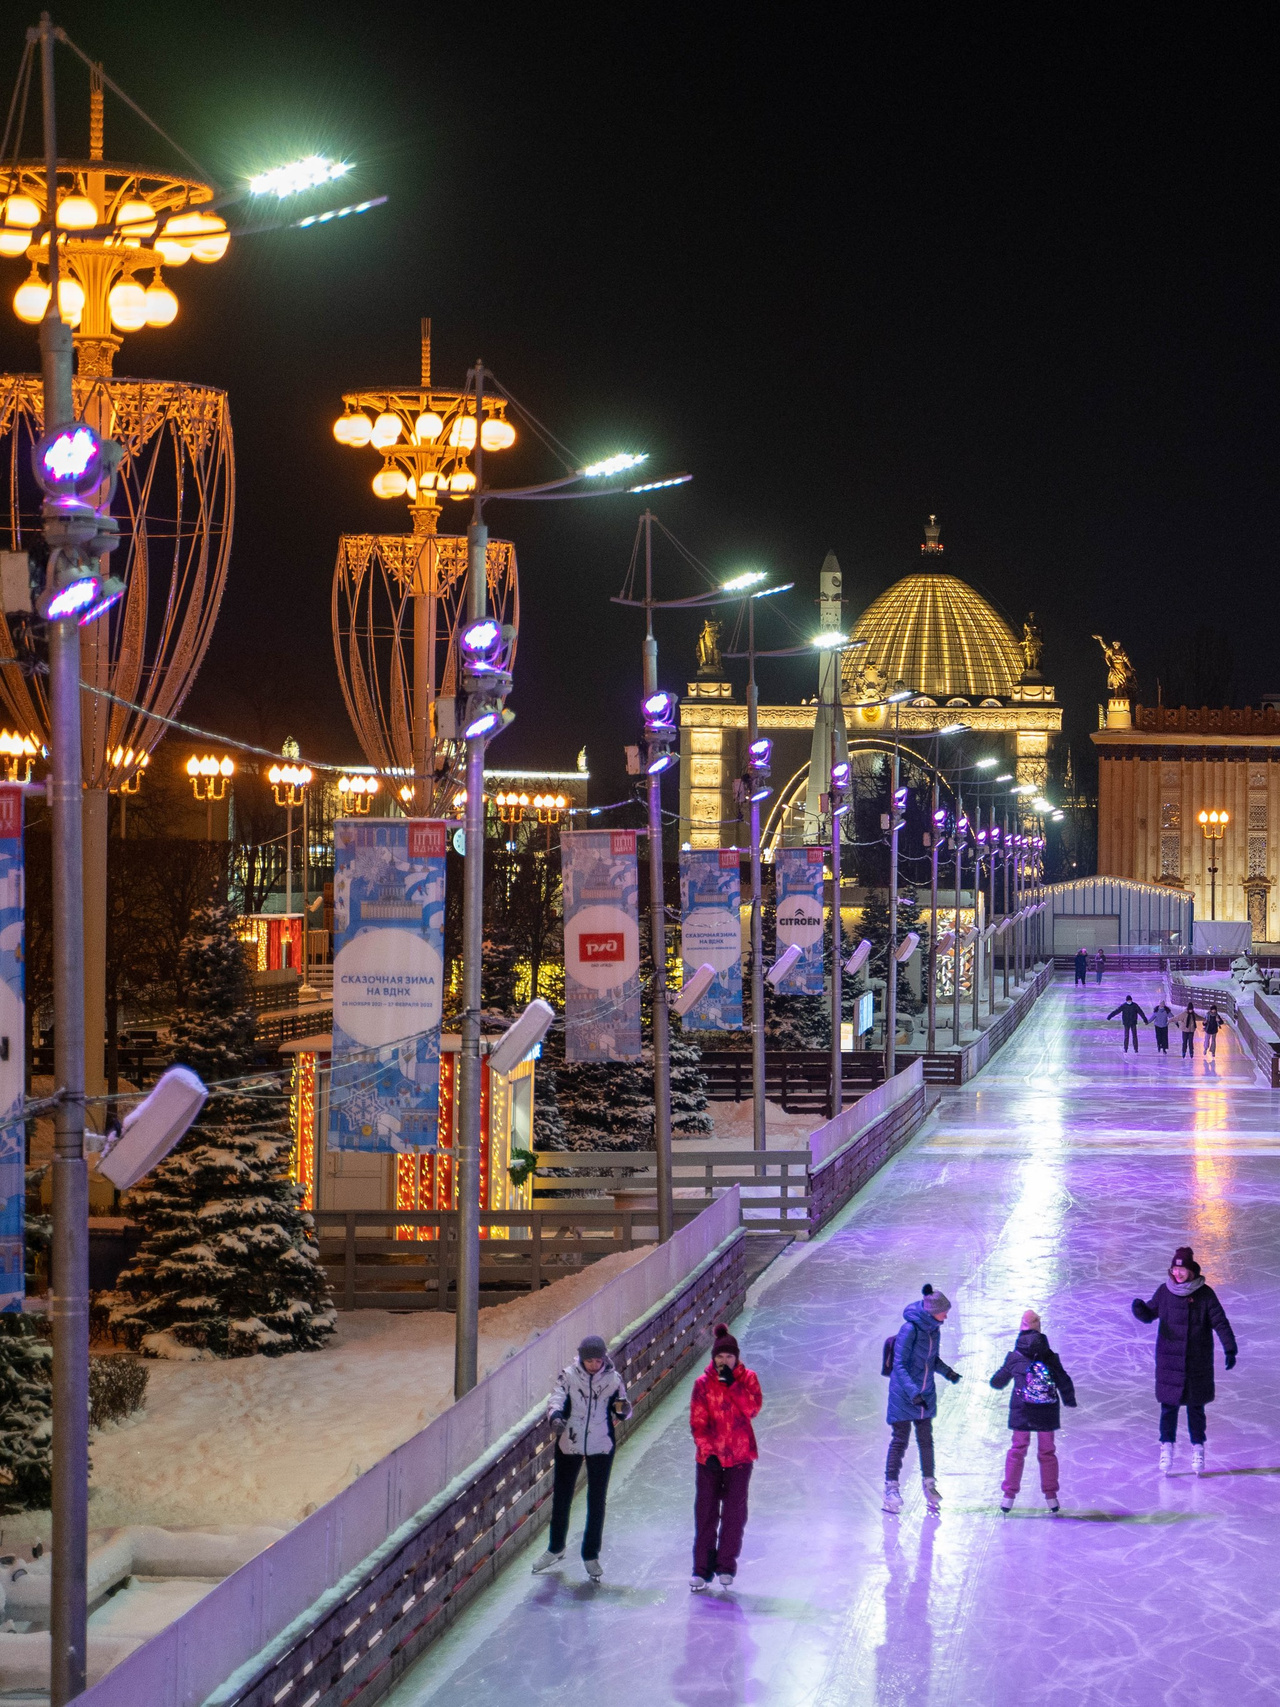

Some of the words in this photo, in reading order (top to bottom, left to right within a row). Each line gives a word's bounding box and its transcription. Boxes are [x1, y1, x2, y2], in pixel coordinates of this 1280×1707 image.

[413, 845, 441, 853] ВДНХ
[779, 916, 821, 926] CITROËN
[340, 975, 403, 984] СКАЗОЧНАЯ
[405, 976, 435, 985] ЗИМА
[366, 987, 380, 996] НА
[383, 987, 411, 997] ВДНХ
